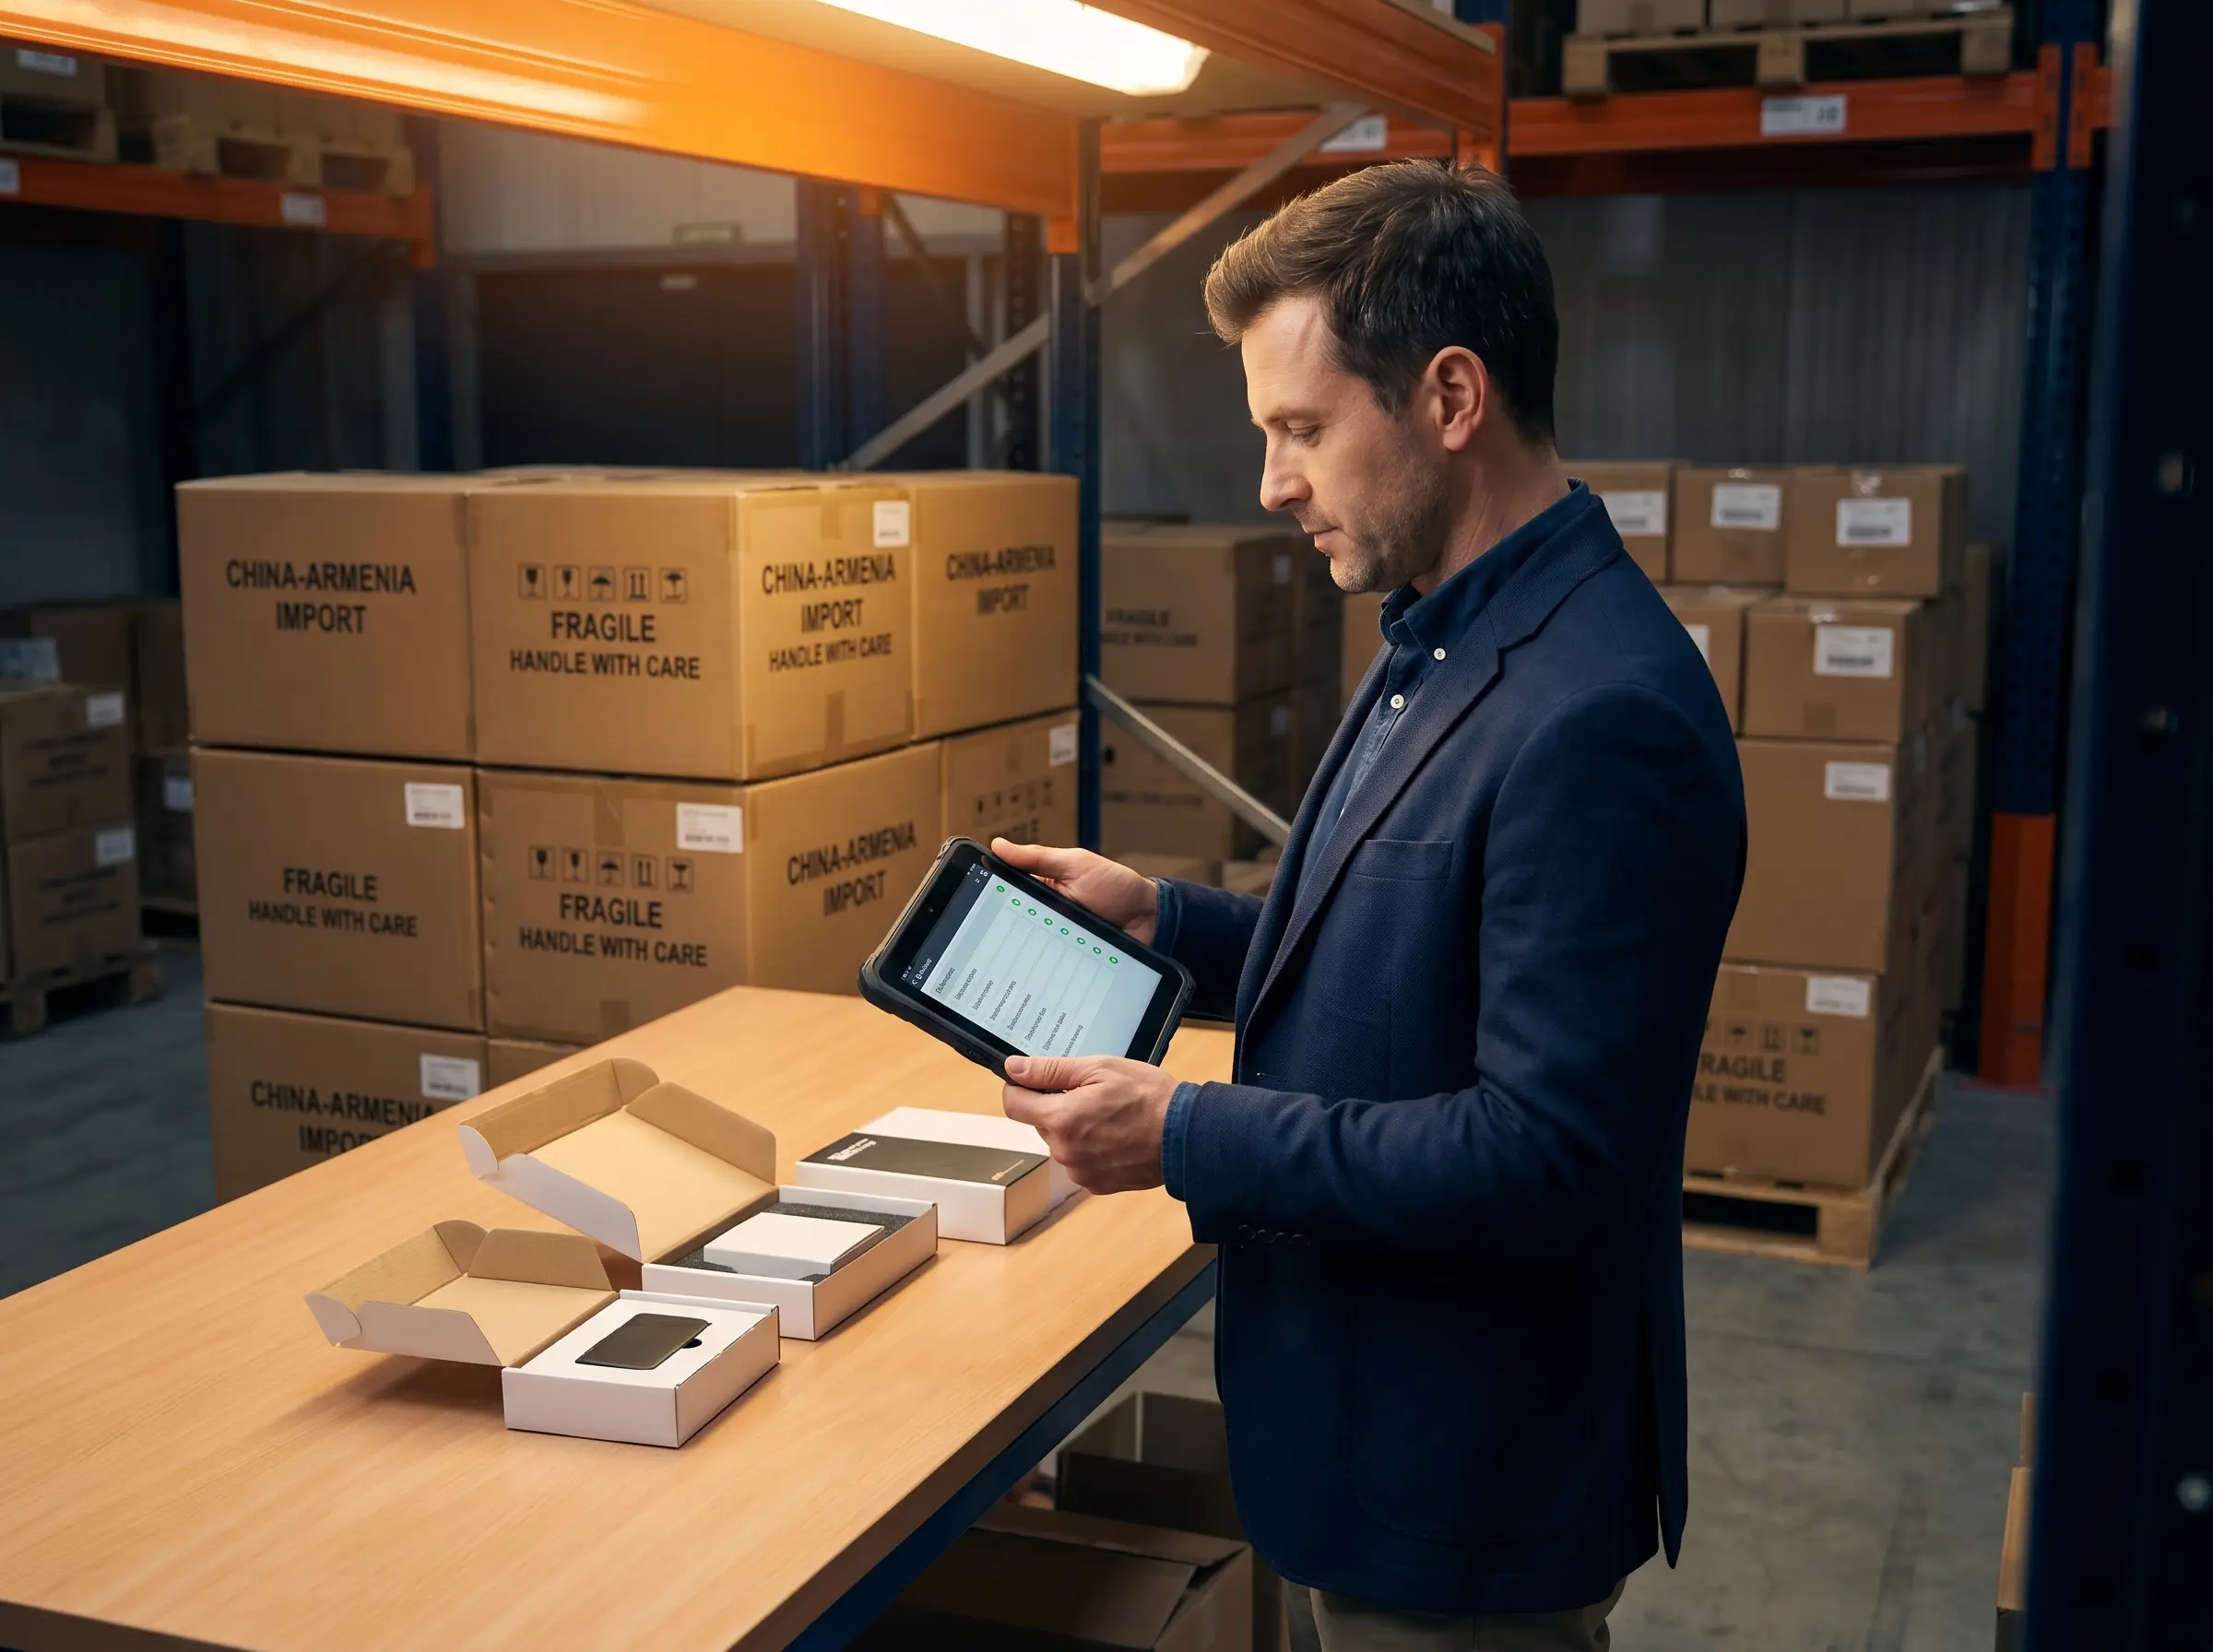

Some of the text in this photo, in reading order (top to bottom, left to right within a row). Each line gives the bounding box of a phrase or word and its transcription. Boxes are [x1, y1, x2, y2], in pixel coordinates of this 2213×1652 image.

[226, 559, 417, 595] CHINA-ARMENIA
[763, 554, 895, 595] CHINA-ARMENIA
[946, 544, 1057, 582] CHINA-ARMENIA
[276, 602, 368, 634] IMPORT
[801, 598, 864, 633] IMPORT
[976, 584, 1029, 616] IMPORT
[550, 610, 657, 643] FRAGILE
[510, 649, 701, 680] HANDLE WITH CARE
[769, 632, 893, 673] HANDLE WITH CARE
[787, 821, 917, 886] CHINA-ARMENIA
[282, 867, 378, 902] FRAGILE
[823, 870, 887, 917] IMPORT
[248, 900, 418, 938] HANDLE WITH CARE
[559, 892, 663, 929] FRAGILE
[519, 926, 708, 968] HANDLE WITH CARE
[1698, 1053, 1788, 1083] RAGILE
